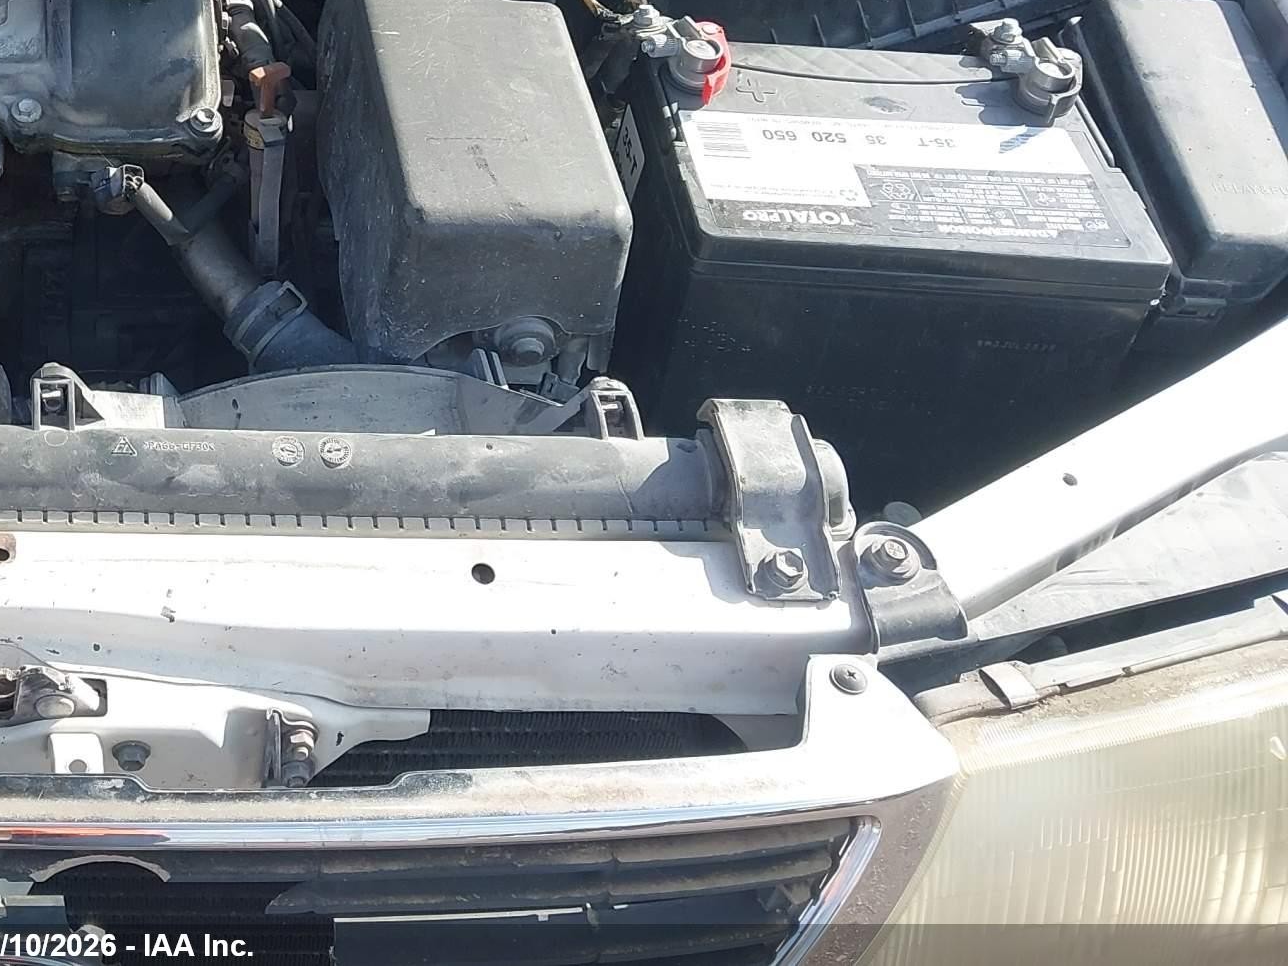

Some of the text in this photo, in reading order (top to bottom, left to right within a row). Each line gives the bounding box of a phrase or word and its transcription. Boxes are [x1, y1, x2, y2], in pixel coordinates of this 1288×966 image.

[761, 128, 957, 149] 35-T 35 520 650
[741, 208, 855, 227] TOTALPRO
